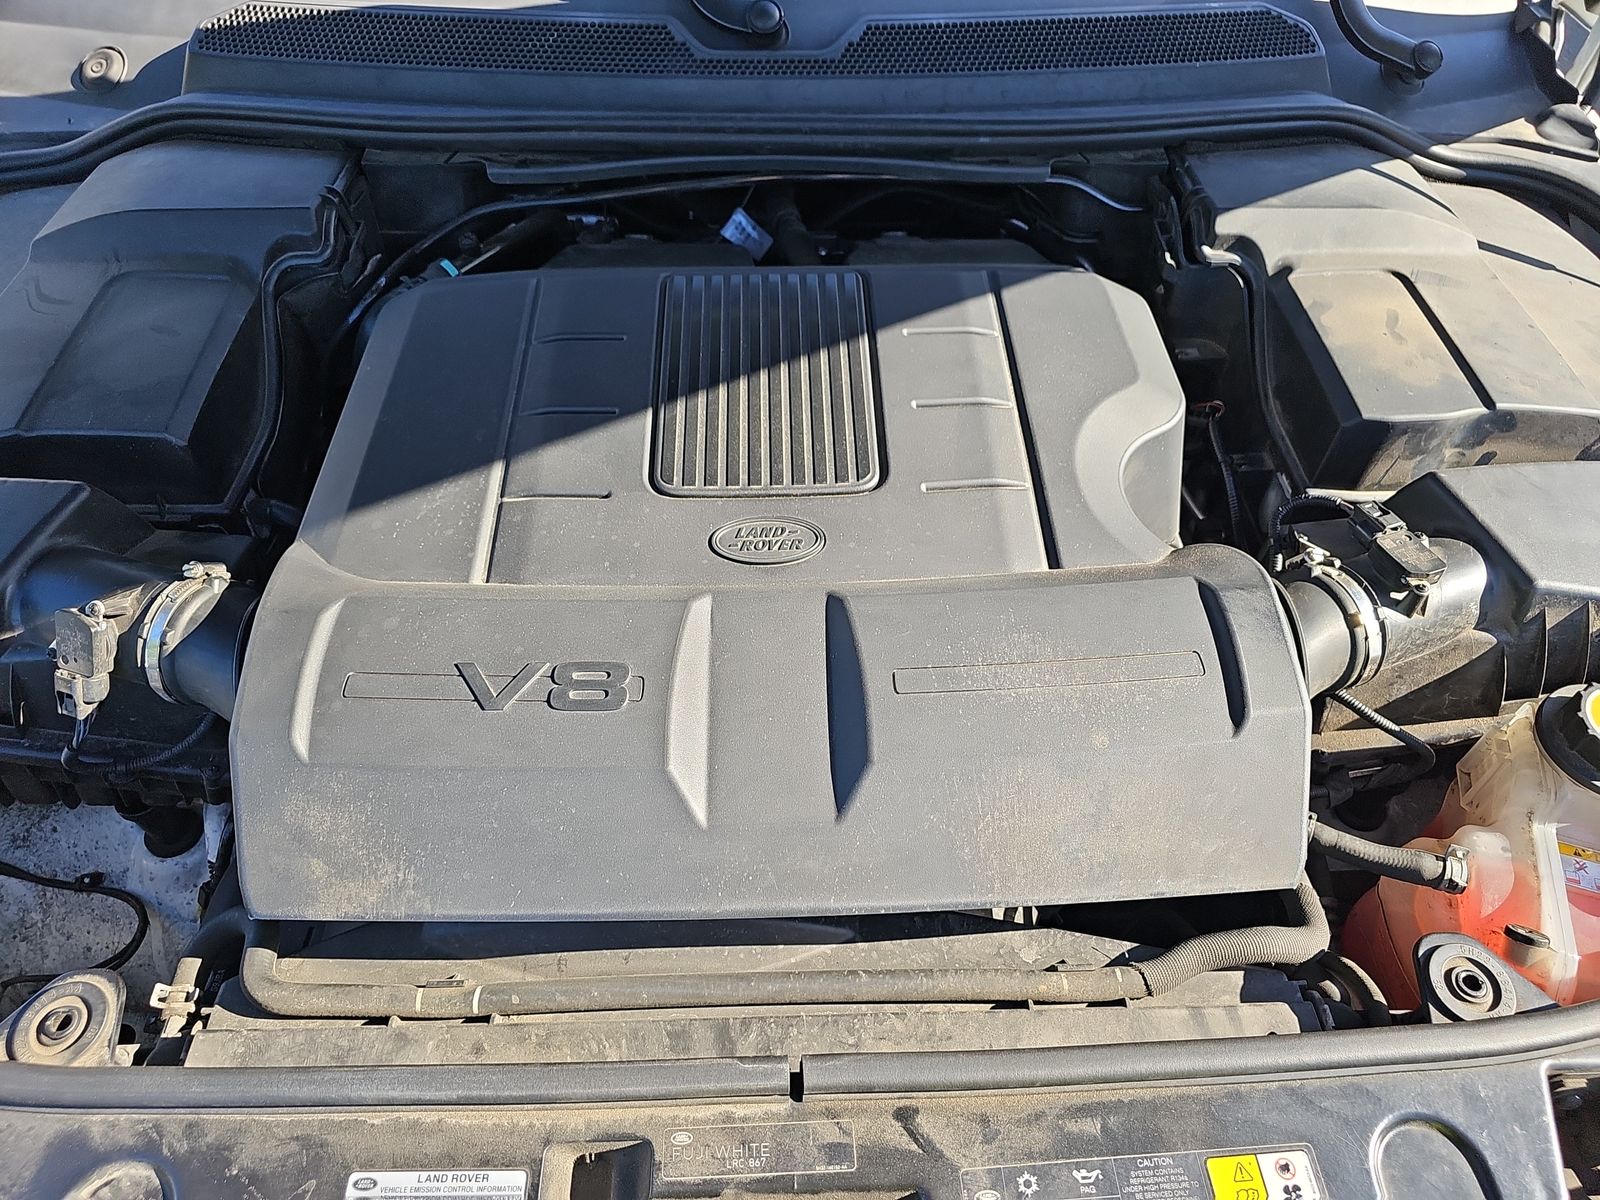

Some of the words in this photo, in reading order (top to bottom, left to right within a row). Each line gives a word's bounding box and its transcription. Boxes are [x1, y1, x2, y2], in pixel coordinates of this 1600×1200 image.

[454, 661, 632, 712] V8
[672, 1147, 709, 1161] FUJI
[716, 1142, 771, 1158] WHITE
[726, 1158, 745, 1169] LRC
[748, 1158, 767, 1168] 867
[1136, 1157, 1174, 1167] CAUTION
[1154, 1167, 1184, 1175] CONTAINS
[417, 1173, 449, 1184] LAND
[451, 1173, 490, 1183] ROVER
[1129, 1176, 1170, 1184] REFRIGERANT
[380, 1186, 408, 1194] VEHICLE
[443, 1185, 475, 1193] CONTROL
[1080, 1185, 1097, 1193] PAG
